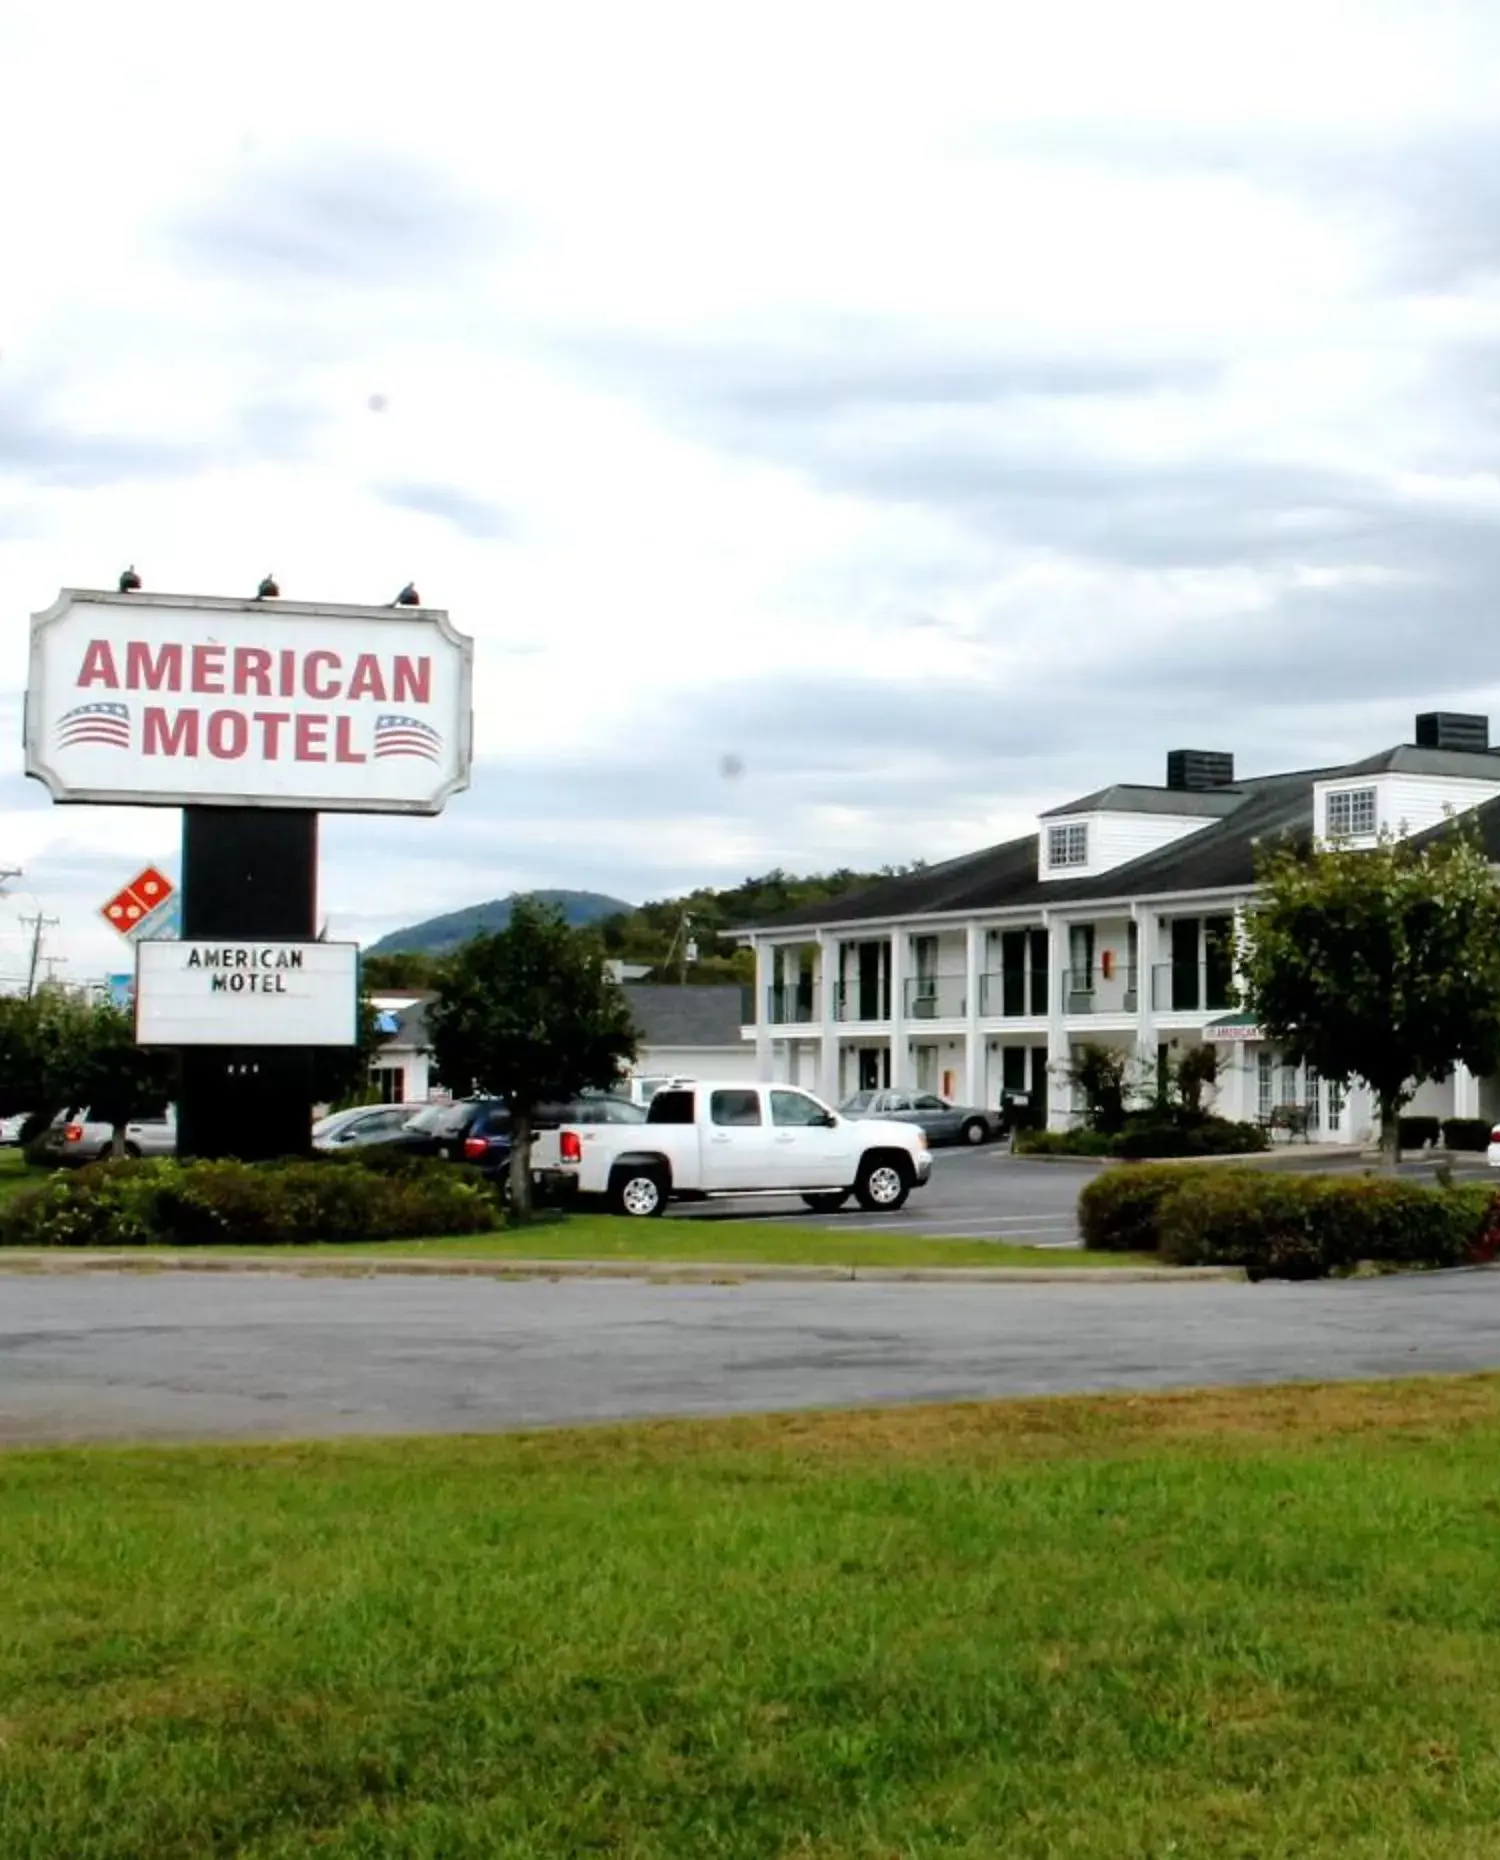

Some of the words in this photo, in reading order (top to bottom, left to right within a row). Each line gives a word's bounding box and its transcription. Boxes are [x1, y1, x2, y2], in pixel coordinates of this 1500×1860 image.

[76, 639, 431, 704] AMERICAN
[142, 707, 367, 764] MOTEL
[187, 947, 303, 969] AMERICAN
[211, 973, 287, 993] MOTEL
